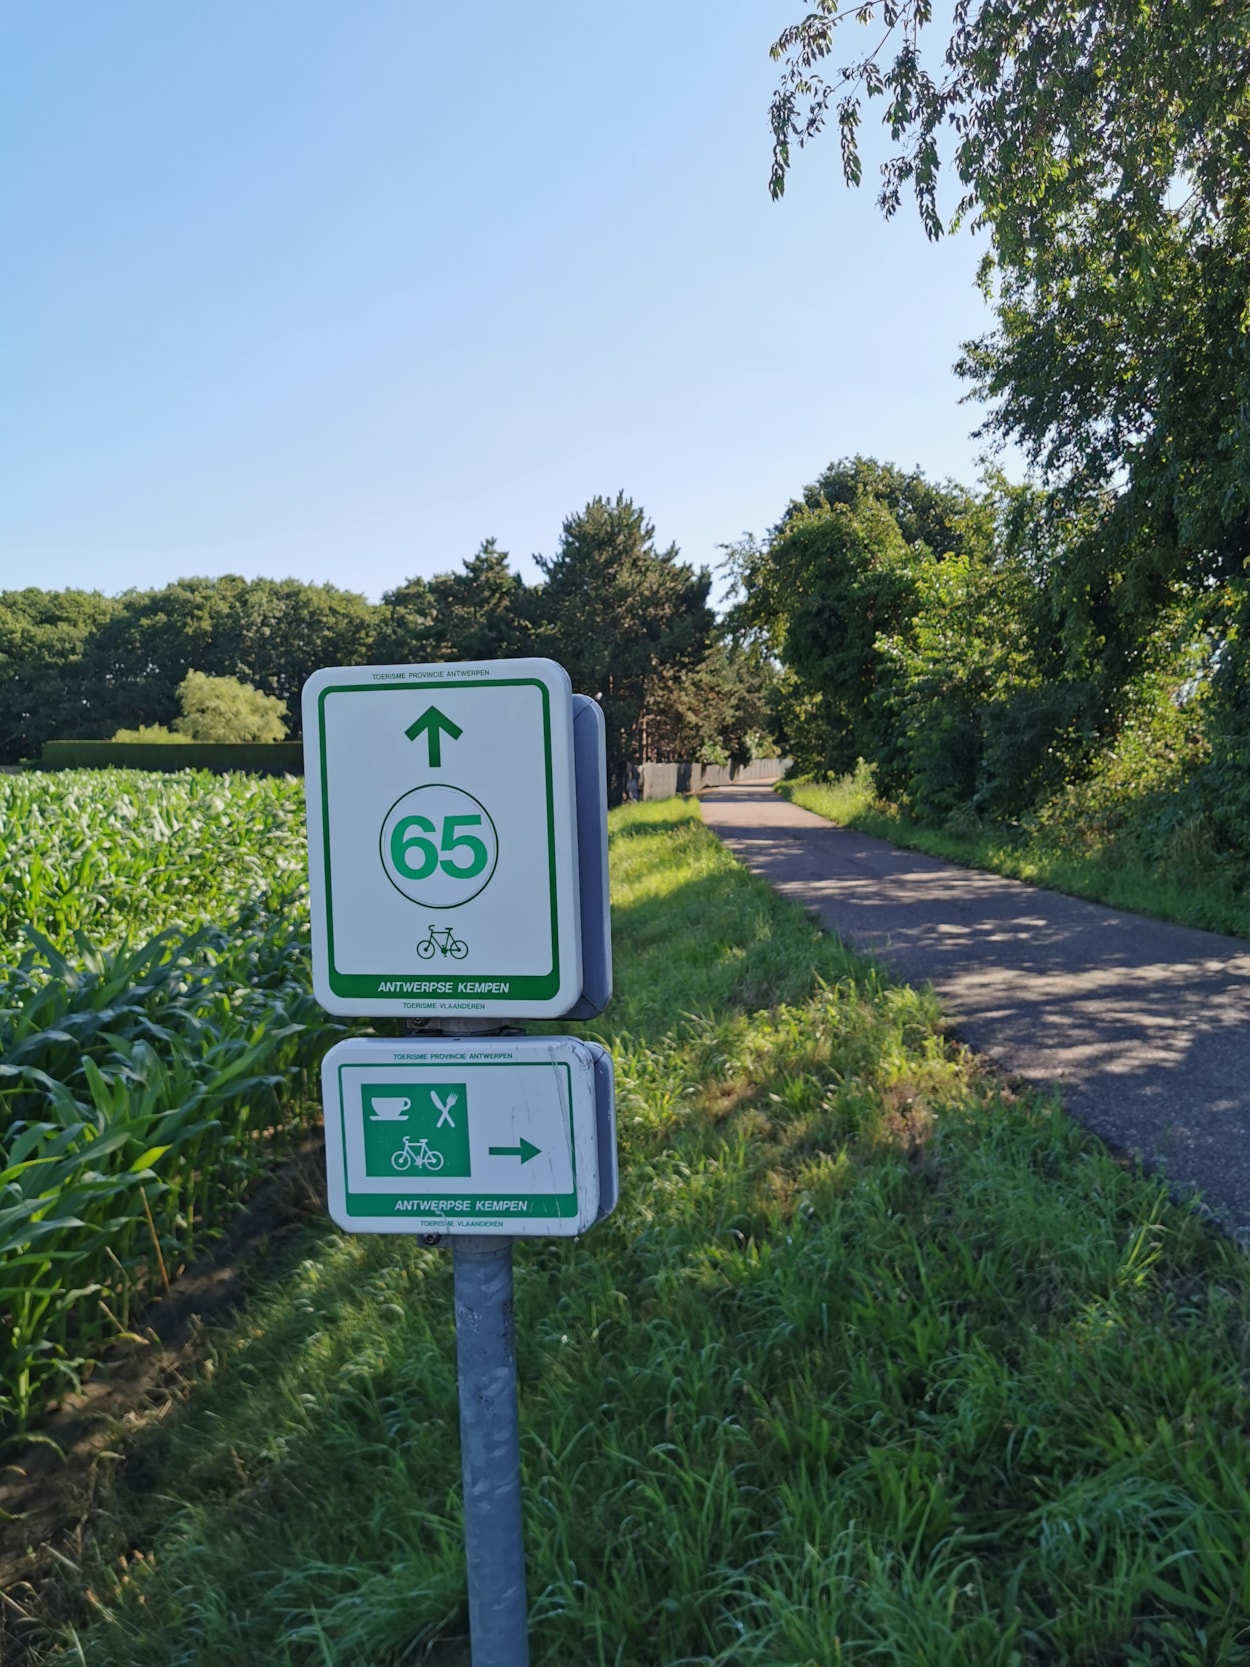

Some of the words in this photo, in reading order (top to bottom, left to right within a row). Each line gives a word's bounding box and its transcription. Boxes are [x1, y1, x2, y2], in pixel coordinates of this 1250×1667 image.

[390, 814, 488, 880] 65
[378, 982, 453, 993] ANTWERPSE
[457, 982, 509, 993] KEMPEN
[469, 1052, 513, 1060] ANTWERPEN
[394, 1200, 471, 1211] ANTWERPSE
[475, 1200, 528, 1211] KEMPEN
